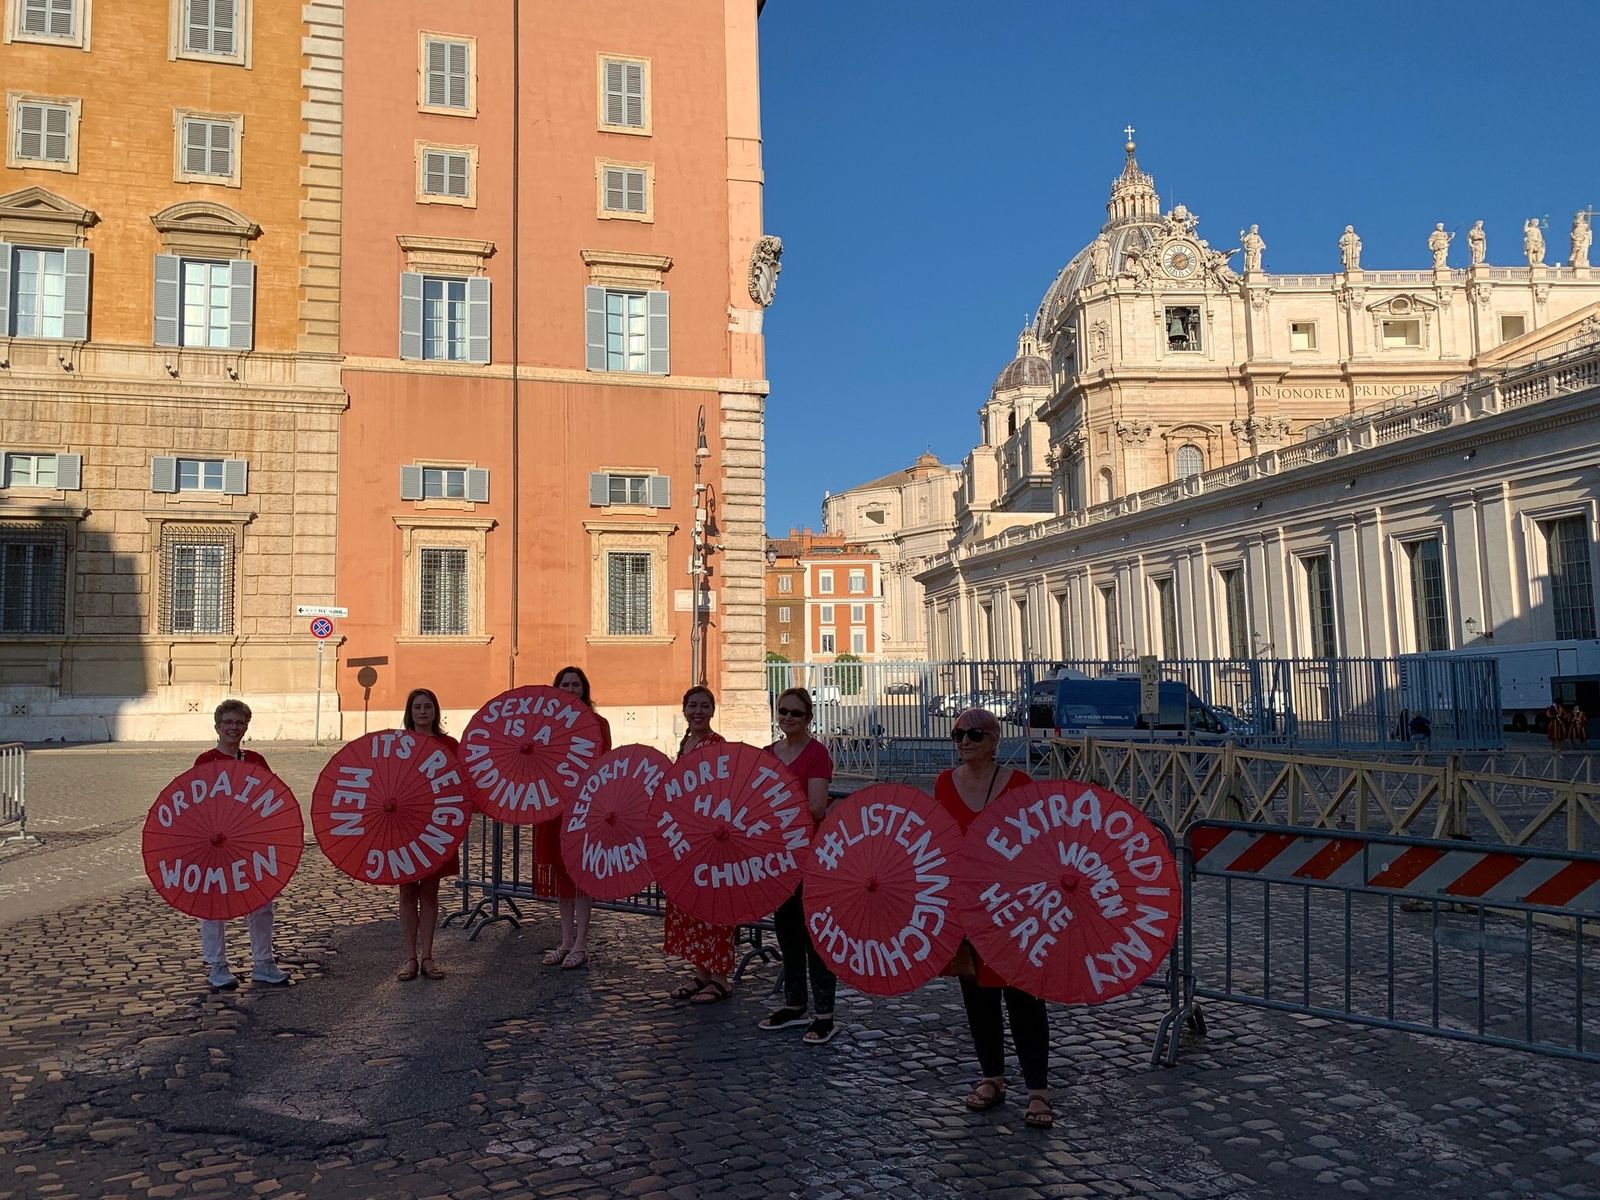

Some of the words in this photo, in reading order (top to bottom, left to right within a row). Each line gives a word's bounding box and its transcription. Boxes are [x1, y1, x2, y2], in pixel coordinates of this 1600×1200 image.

[1255, 385, 1271, 397] IN
[483, 696, 581, 728] SEXISM
[504, 718, 525, 737] IS
[533, 725, 551, 746] A
[371, 729, 416, 760] IT'S
[465, 728, 560, 811] CARDINAL
[556, 736, 595, 788] SIN
[158, 770, 285, 828] ORDAIN
[330, 766, 373, 836] MEN
[366, 749, 465, 880] REIGNING
[567, 757, 629, 832] REFORM
[664, 754, 730, 802] MORE
[751, 766, 810, 850] THAN
[693, 794, 772, 838] HALF
[581, 833, 648, 880] WOMEN
[656, 811, 691, 861] THE
[159, 845, 278, 894] WOMEN
[693, 851, 798, 888] CHURCH
[986, 789, 1170, 994] EXTRAORDINARY
[1058, 840, 1129, 919] WOMEN
[979, 882, 1058, 968] HERE
[1017, 881, 1074, 933] ARE
